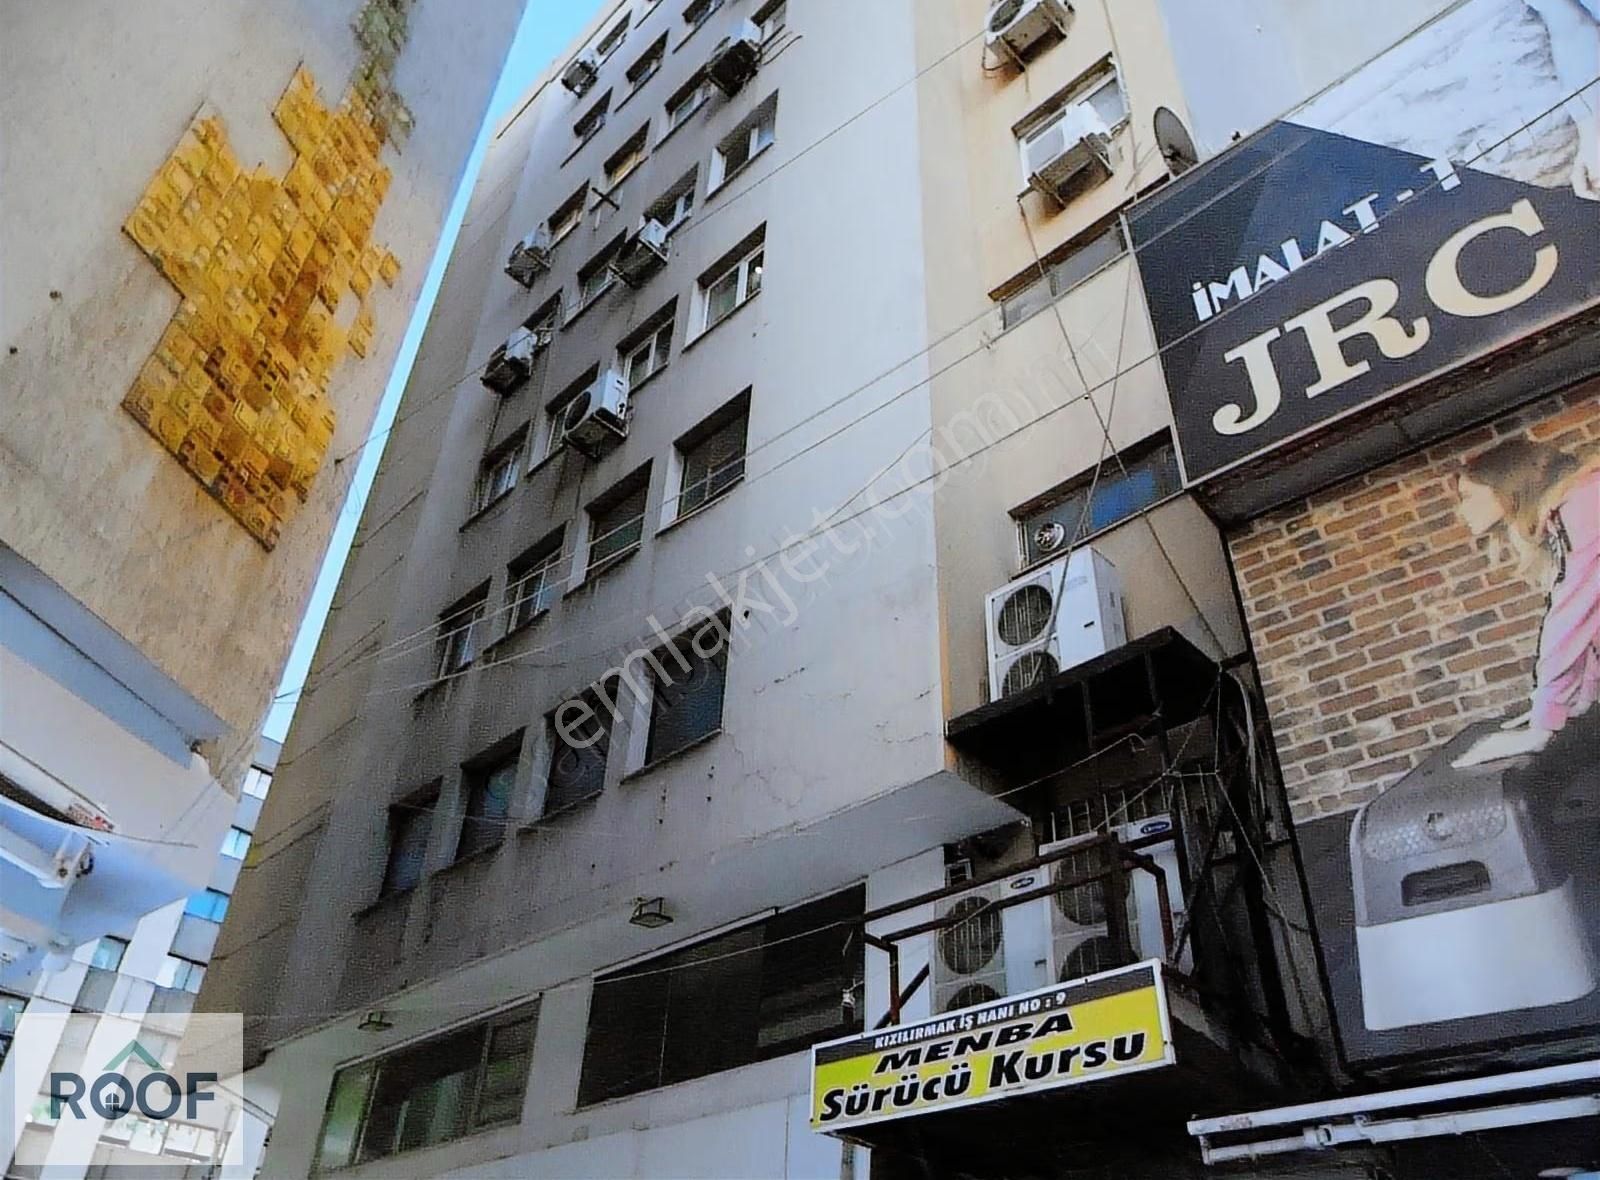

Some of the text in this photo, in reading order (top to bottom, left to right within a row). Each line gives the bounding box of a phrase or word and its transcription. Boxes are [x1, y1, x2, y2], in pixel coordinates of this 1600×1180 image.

[1191, 192, 1380, 322] İMALAT
[1212, 198, 1559, 436] JRC
[873, 1012, 1074, 1075] MENBA
[1018, 998, 1041, 1015] NO
[1055, 991, 1067, 1005] 9
[819, 1033, 1146, 1122] Sürücü Kursu
